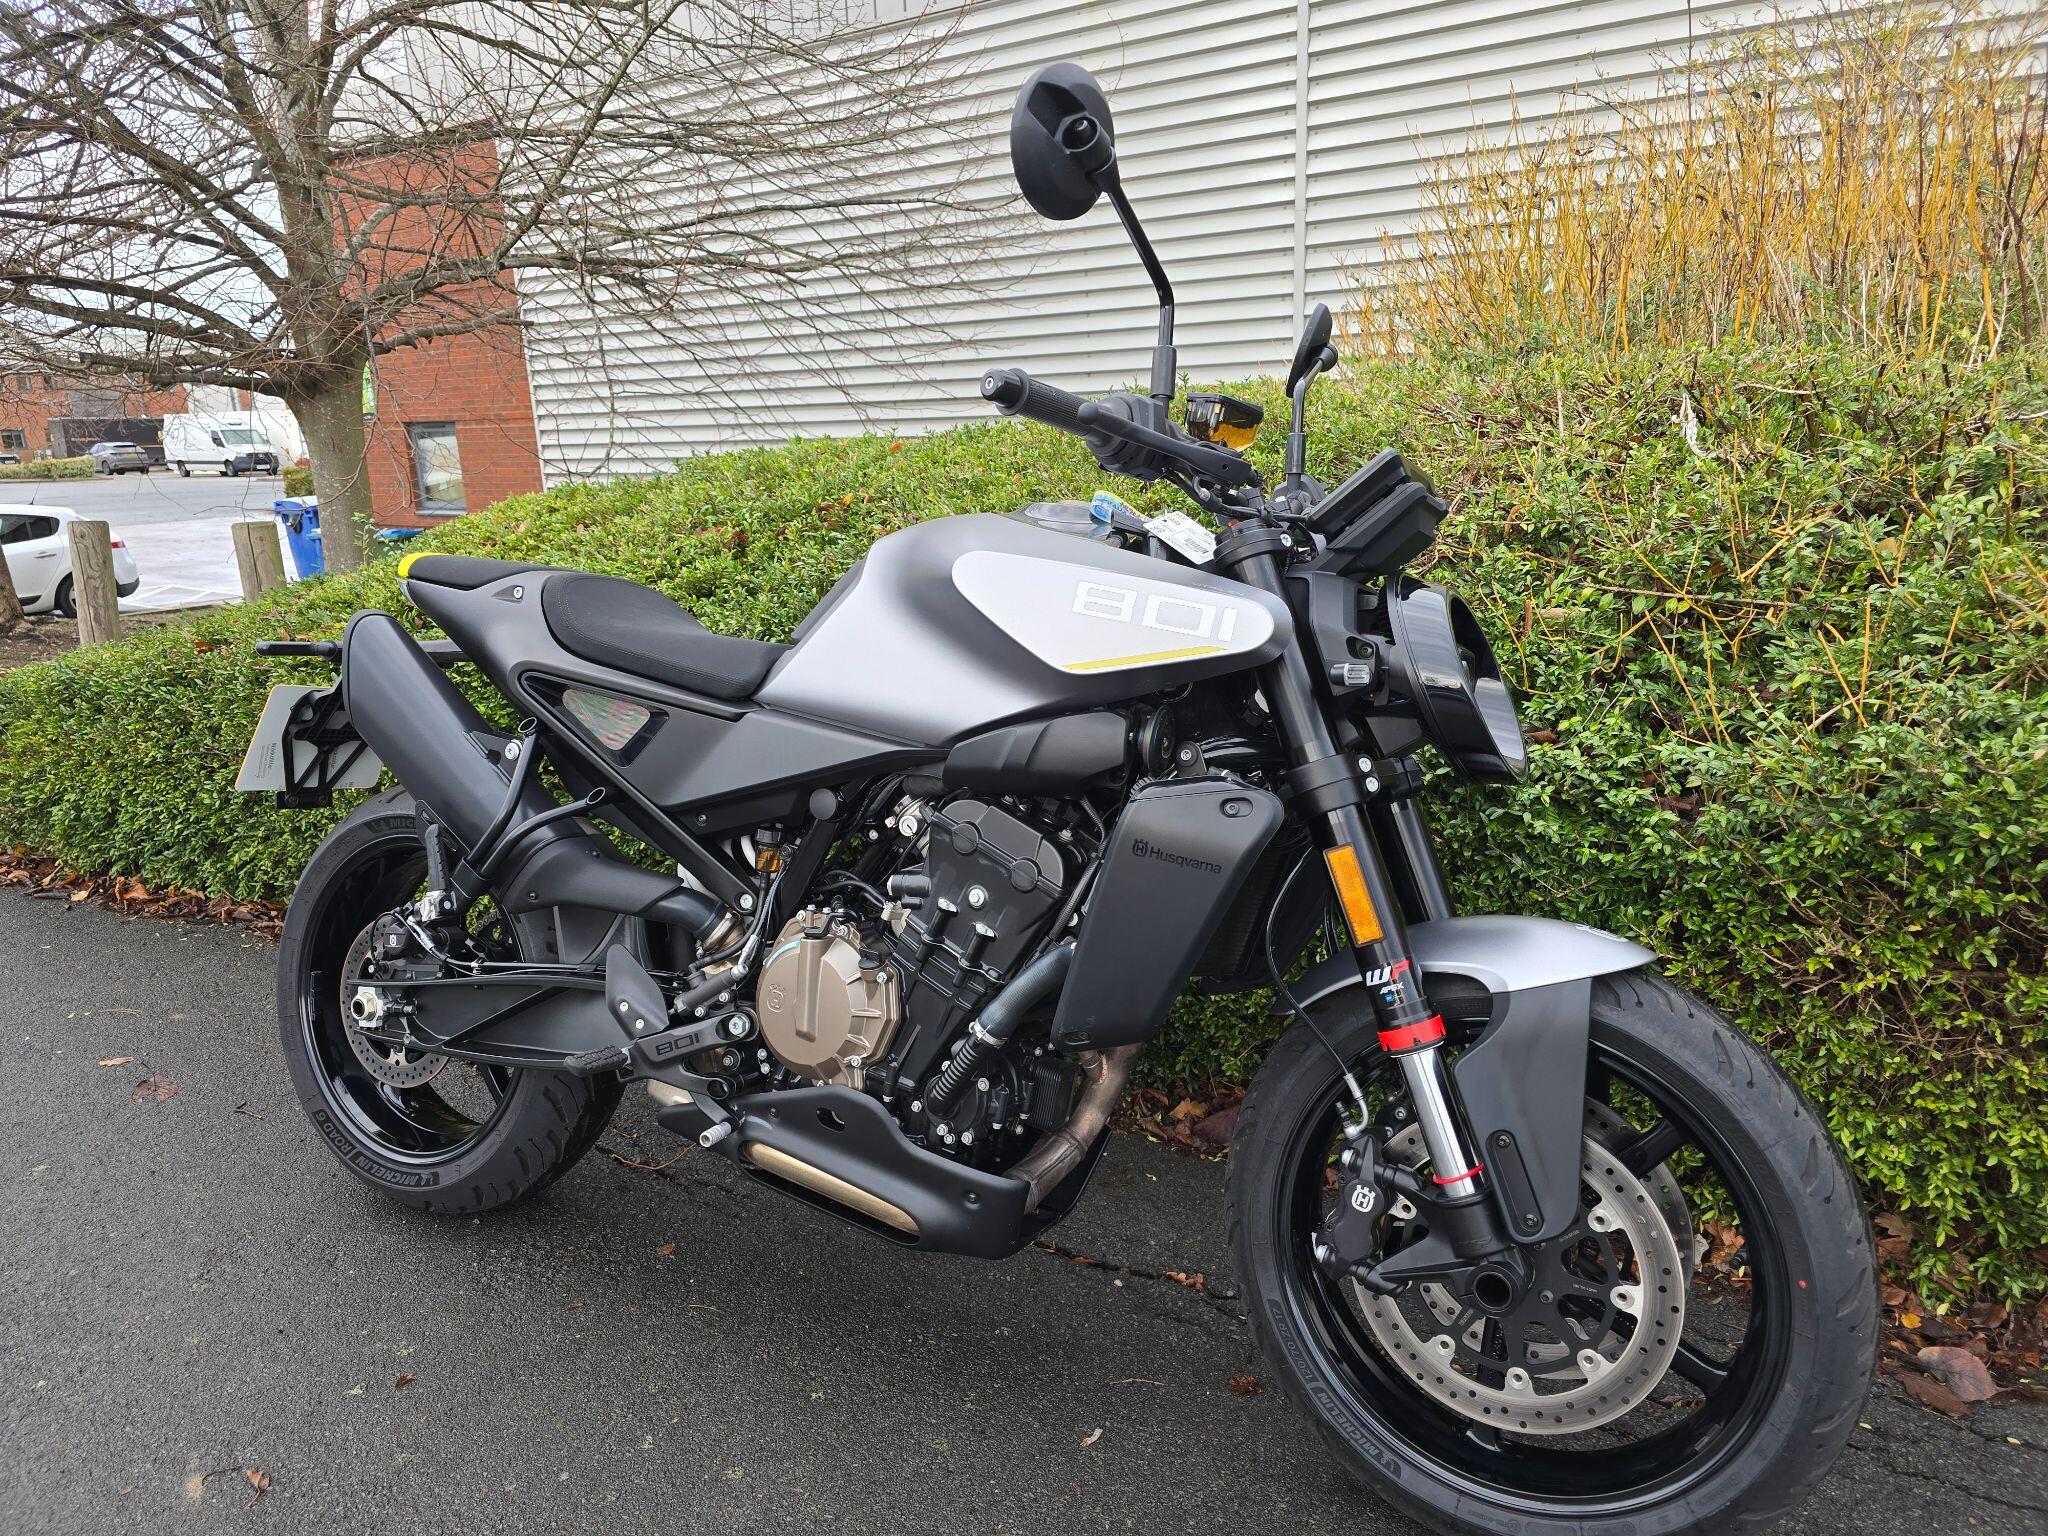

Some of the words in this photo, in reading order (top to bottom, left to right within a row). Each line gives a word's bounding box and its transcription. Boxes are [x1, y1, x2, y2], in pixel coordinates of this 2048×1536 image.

[1072, 581, 1239, 642] 801
[1149, 846, 1222, 874] Husqvarna
[1365, 959, 1410, 987] WP
[1379, 981, 1405, 995] APEX
[655, 1032, 700, 1056] 801
[315, 1110, 327, 1120] 6
[323, 1122, 353, 1154] ROAD
[354, 1155, 419, 1186] MICHELIN
[1287, 1342, 1314, 1380] 120/70
[1317, 1391, 1378, 1457] MICHELIN
